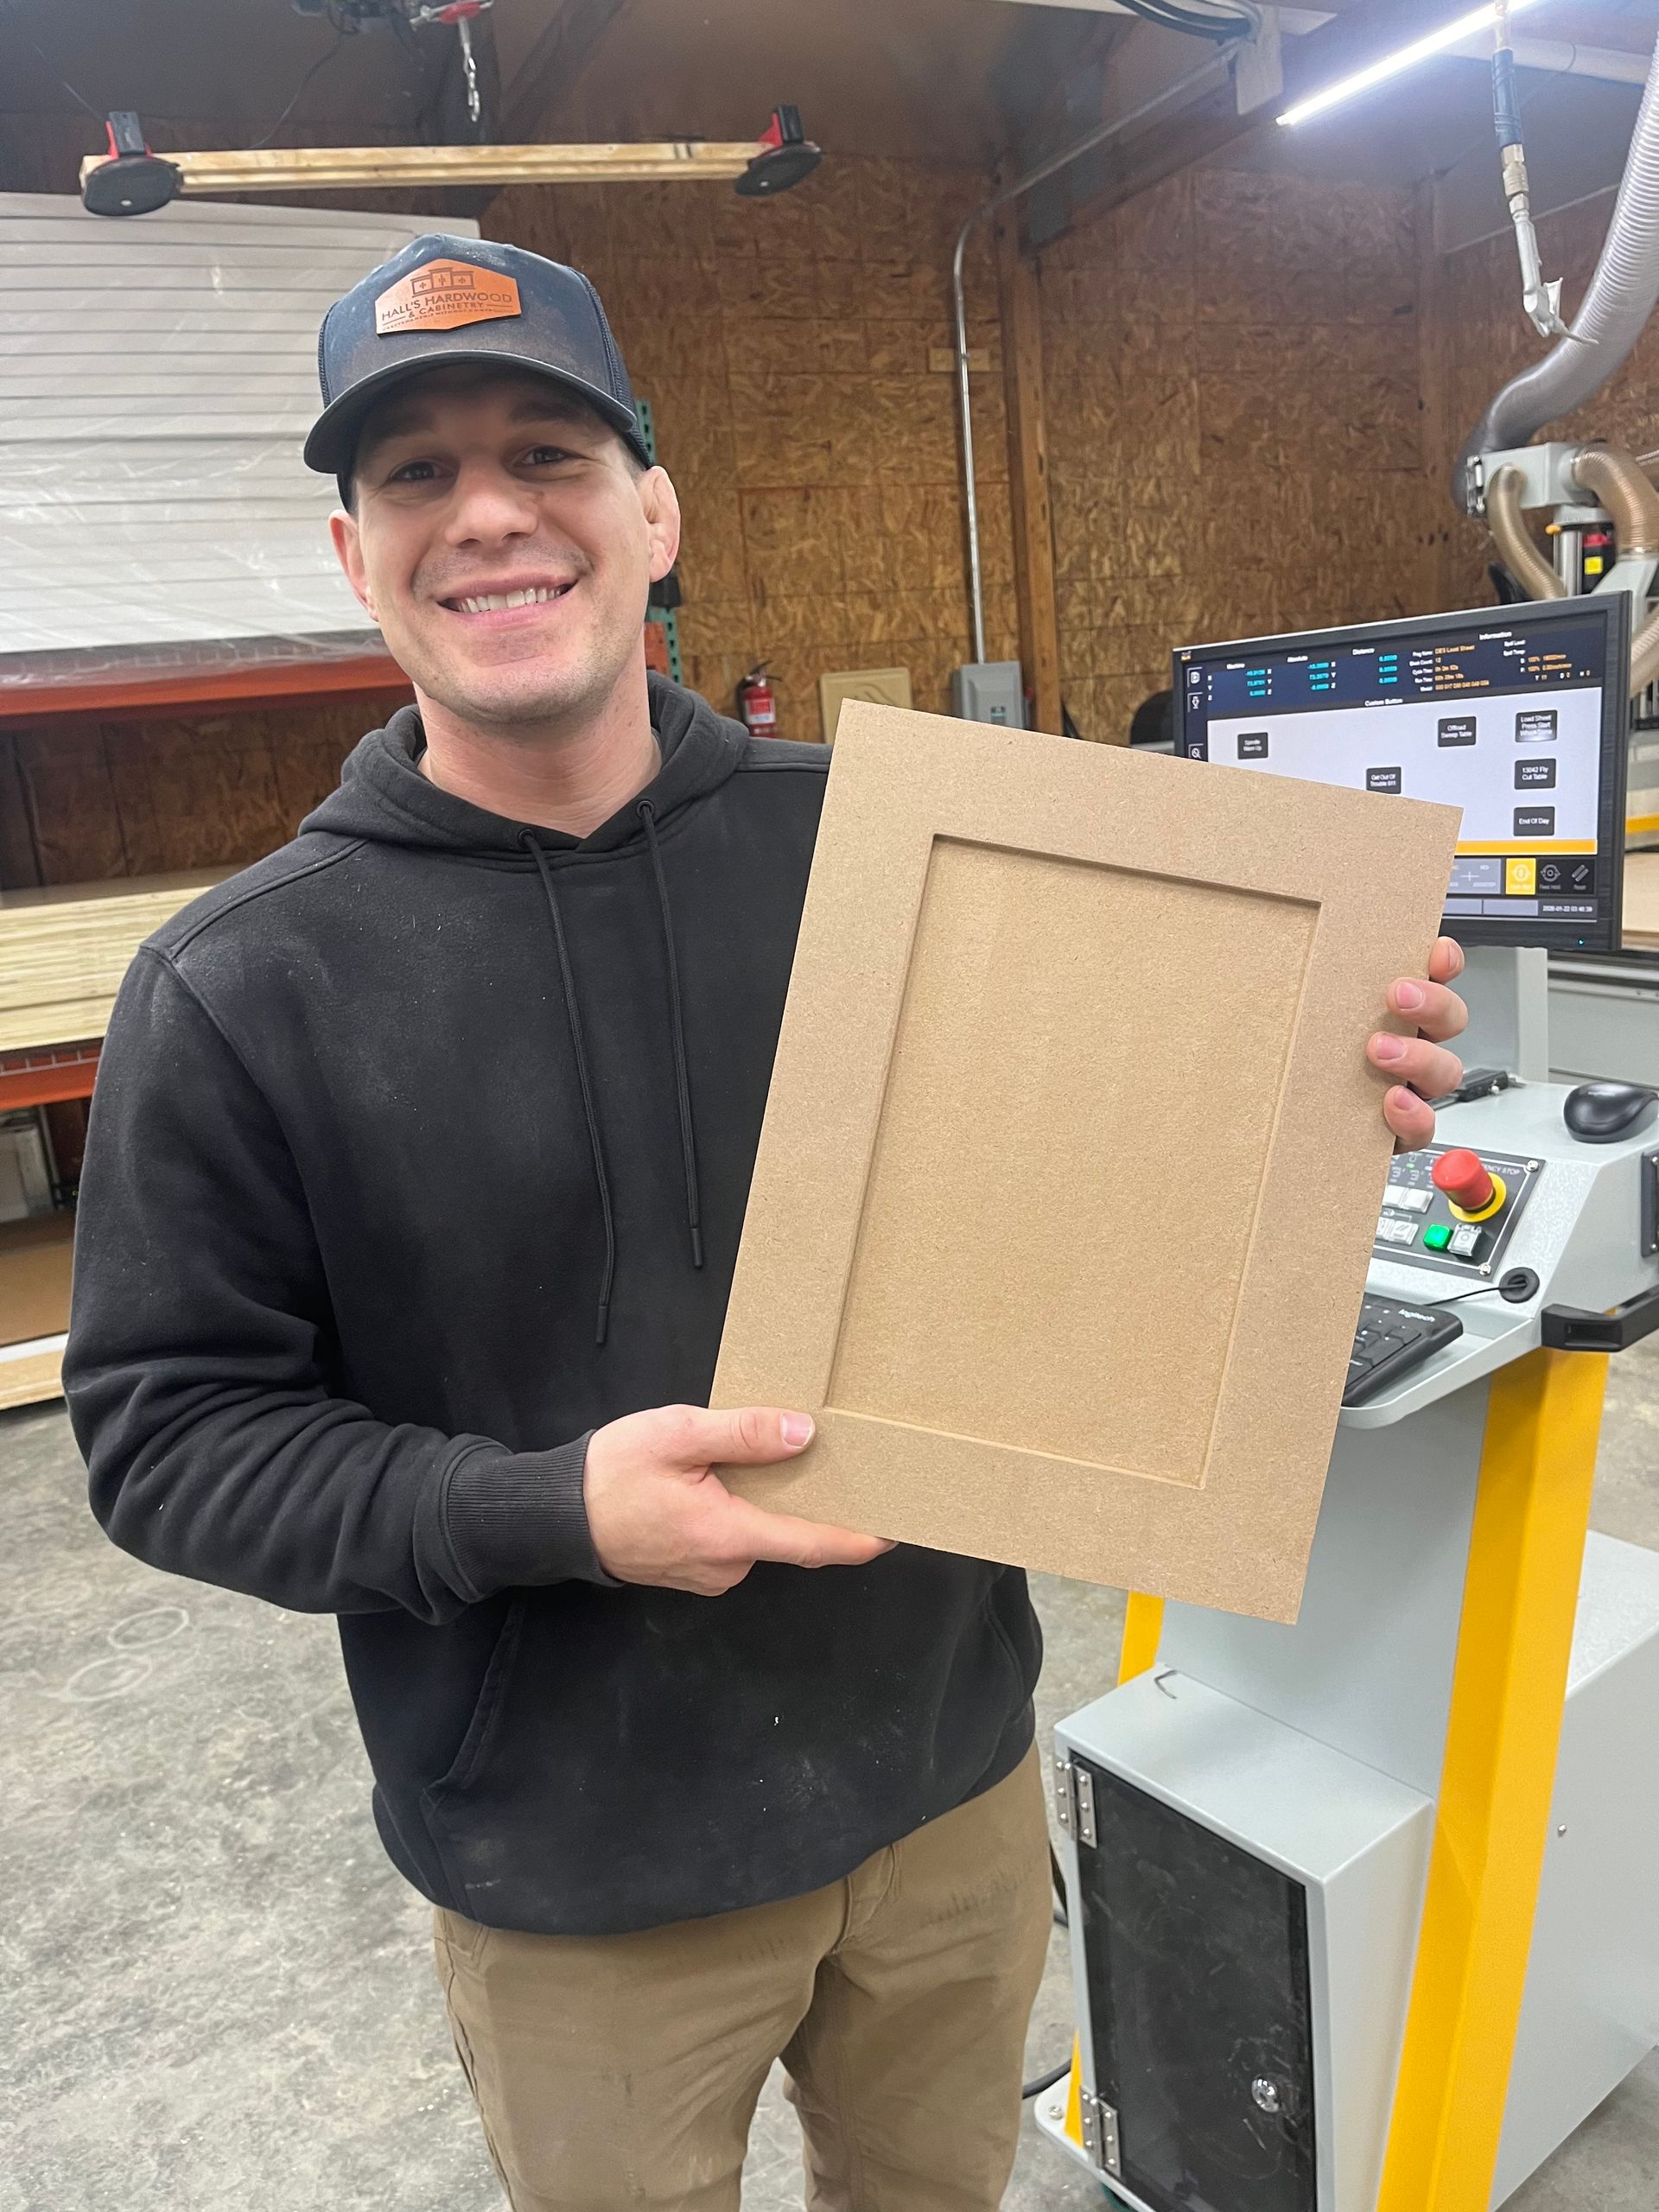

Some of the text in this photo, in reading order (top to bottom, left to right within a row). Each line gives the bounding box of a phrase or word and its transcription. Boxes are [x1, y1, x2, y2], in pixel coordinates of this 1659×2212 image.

[382, 292, 512, 321] HALL'S HARDWOOD
[419, 302, 484, 315] CABINETRY
